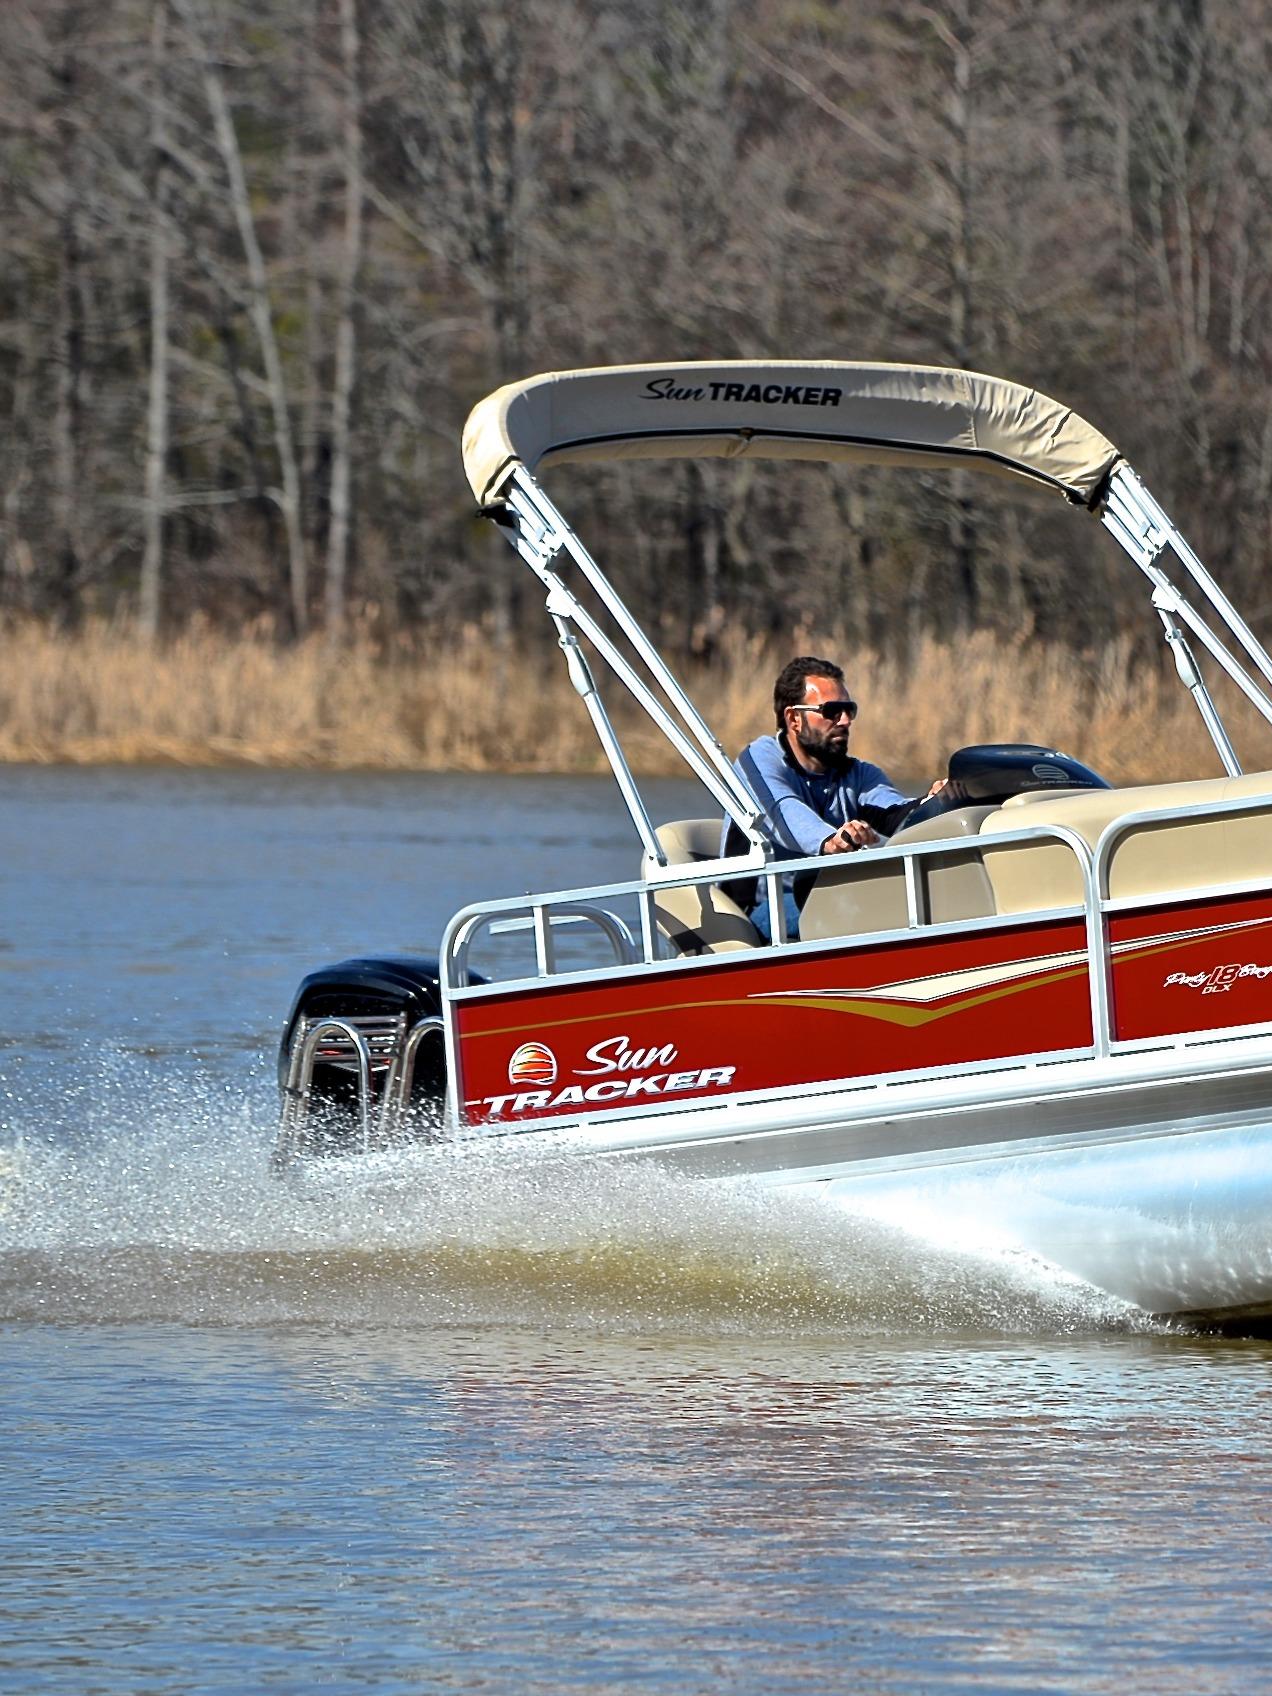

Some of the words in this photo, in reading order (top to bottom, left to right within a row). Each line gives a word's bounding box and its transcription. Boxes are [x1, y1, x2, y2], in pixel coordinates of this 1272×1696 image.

[638, 378, 706, 400] Sun
[709, 382, 843, 406] TRACKER
[1202, 983, 1232, 994] DLX
[1206, 963, 1241, 986] 18
[572, 1036, 679, 1075] Sun
[483, 1066, 736, 1115] TRACKER
